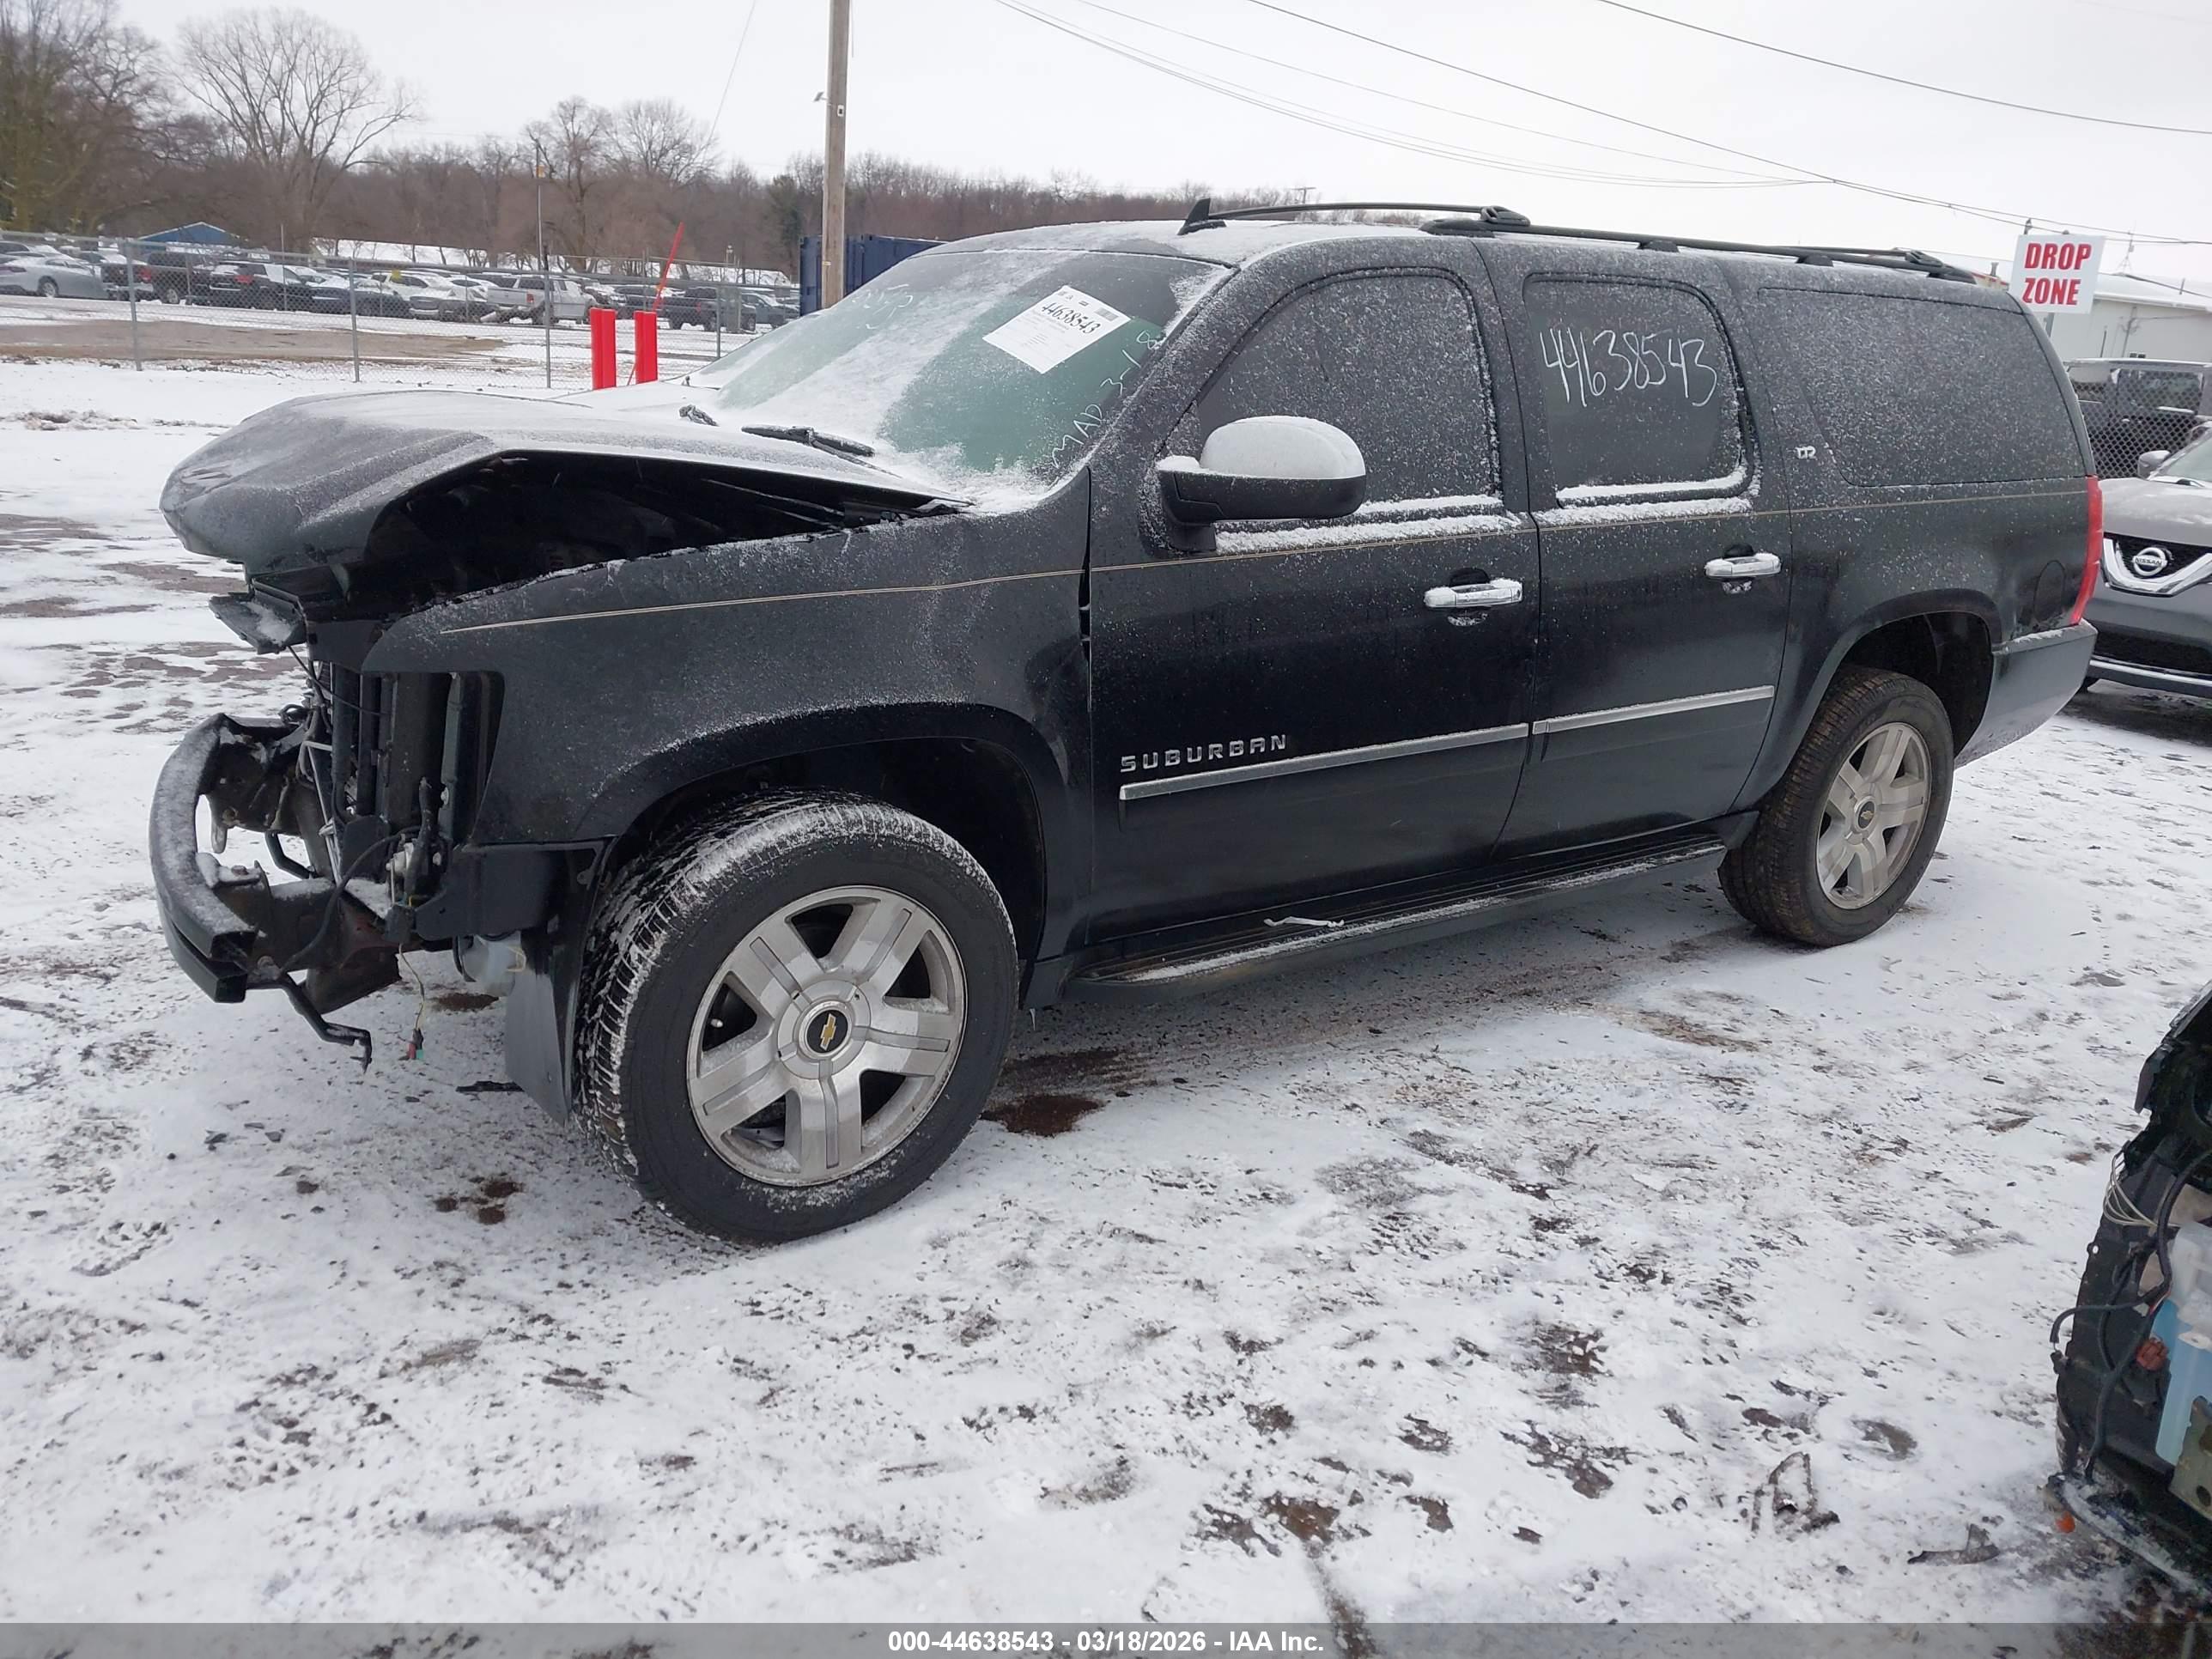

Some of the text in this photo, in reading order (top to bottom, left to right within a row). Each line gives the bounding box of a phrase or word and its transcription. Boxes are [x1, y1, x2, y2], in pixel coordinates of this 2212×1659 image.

[2024, 242, 2093, 270] DROP
[2021, 276, 2082, 306] ZONE
[1041, 301, 1102, 335] 44638543
[1539, 326, 1718, 408] 44638543
[2134, 556, 2163, 566] NISSAN
[1120, 733, 1287, 774] SUBURBAN
